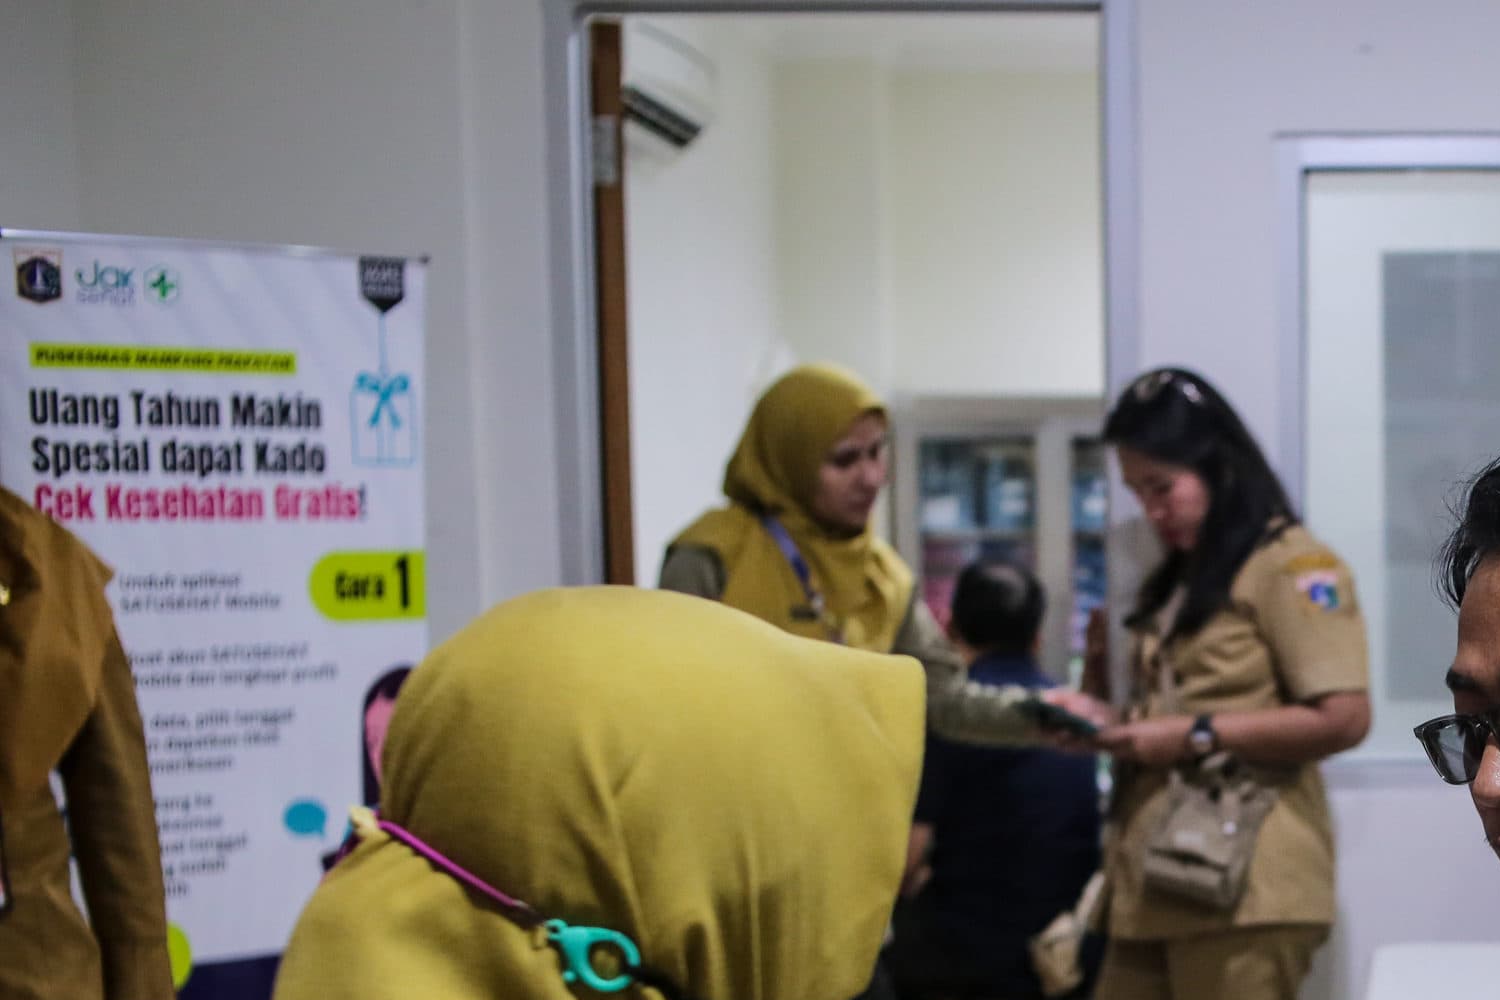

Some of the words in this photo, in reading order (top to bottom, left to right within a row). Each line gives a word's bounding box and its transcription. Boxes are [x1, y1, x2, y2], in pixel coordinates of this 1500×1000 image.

[29, 387, 120, 429] Ulang
[129, 391, 220, 428] Tahun
[230, 394, 321, 429] Makin
[31, 436, 149, 477] Spesial
[161, 439, 244, 477] dapat
[254, 439, 327, 474] Kado
[34, 482, 95, 522] Cek
[106, 484, 264, 522] Kesehatan
[275, 484, 368, 521] Gratis!
[334, 571, 386, 600] Cara
[394, 554, 411, 610] 1
